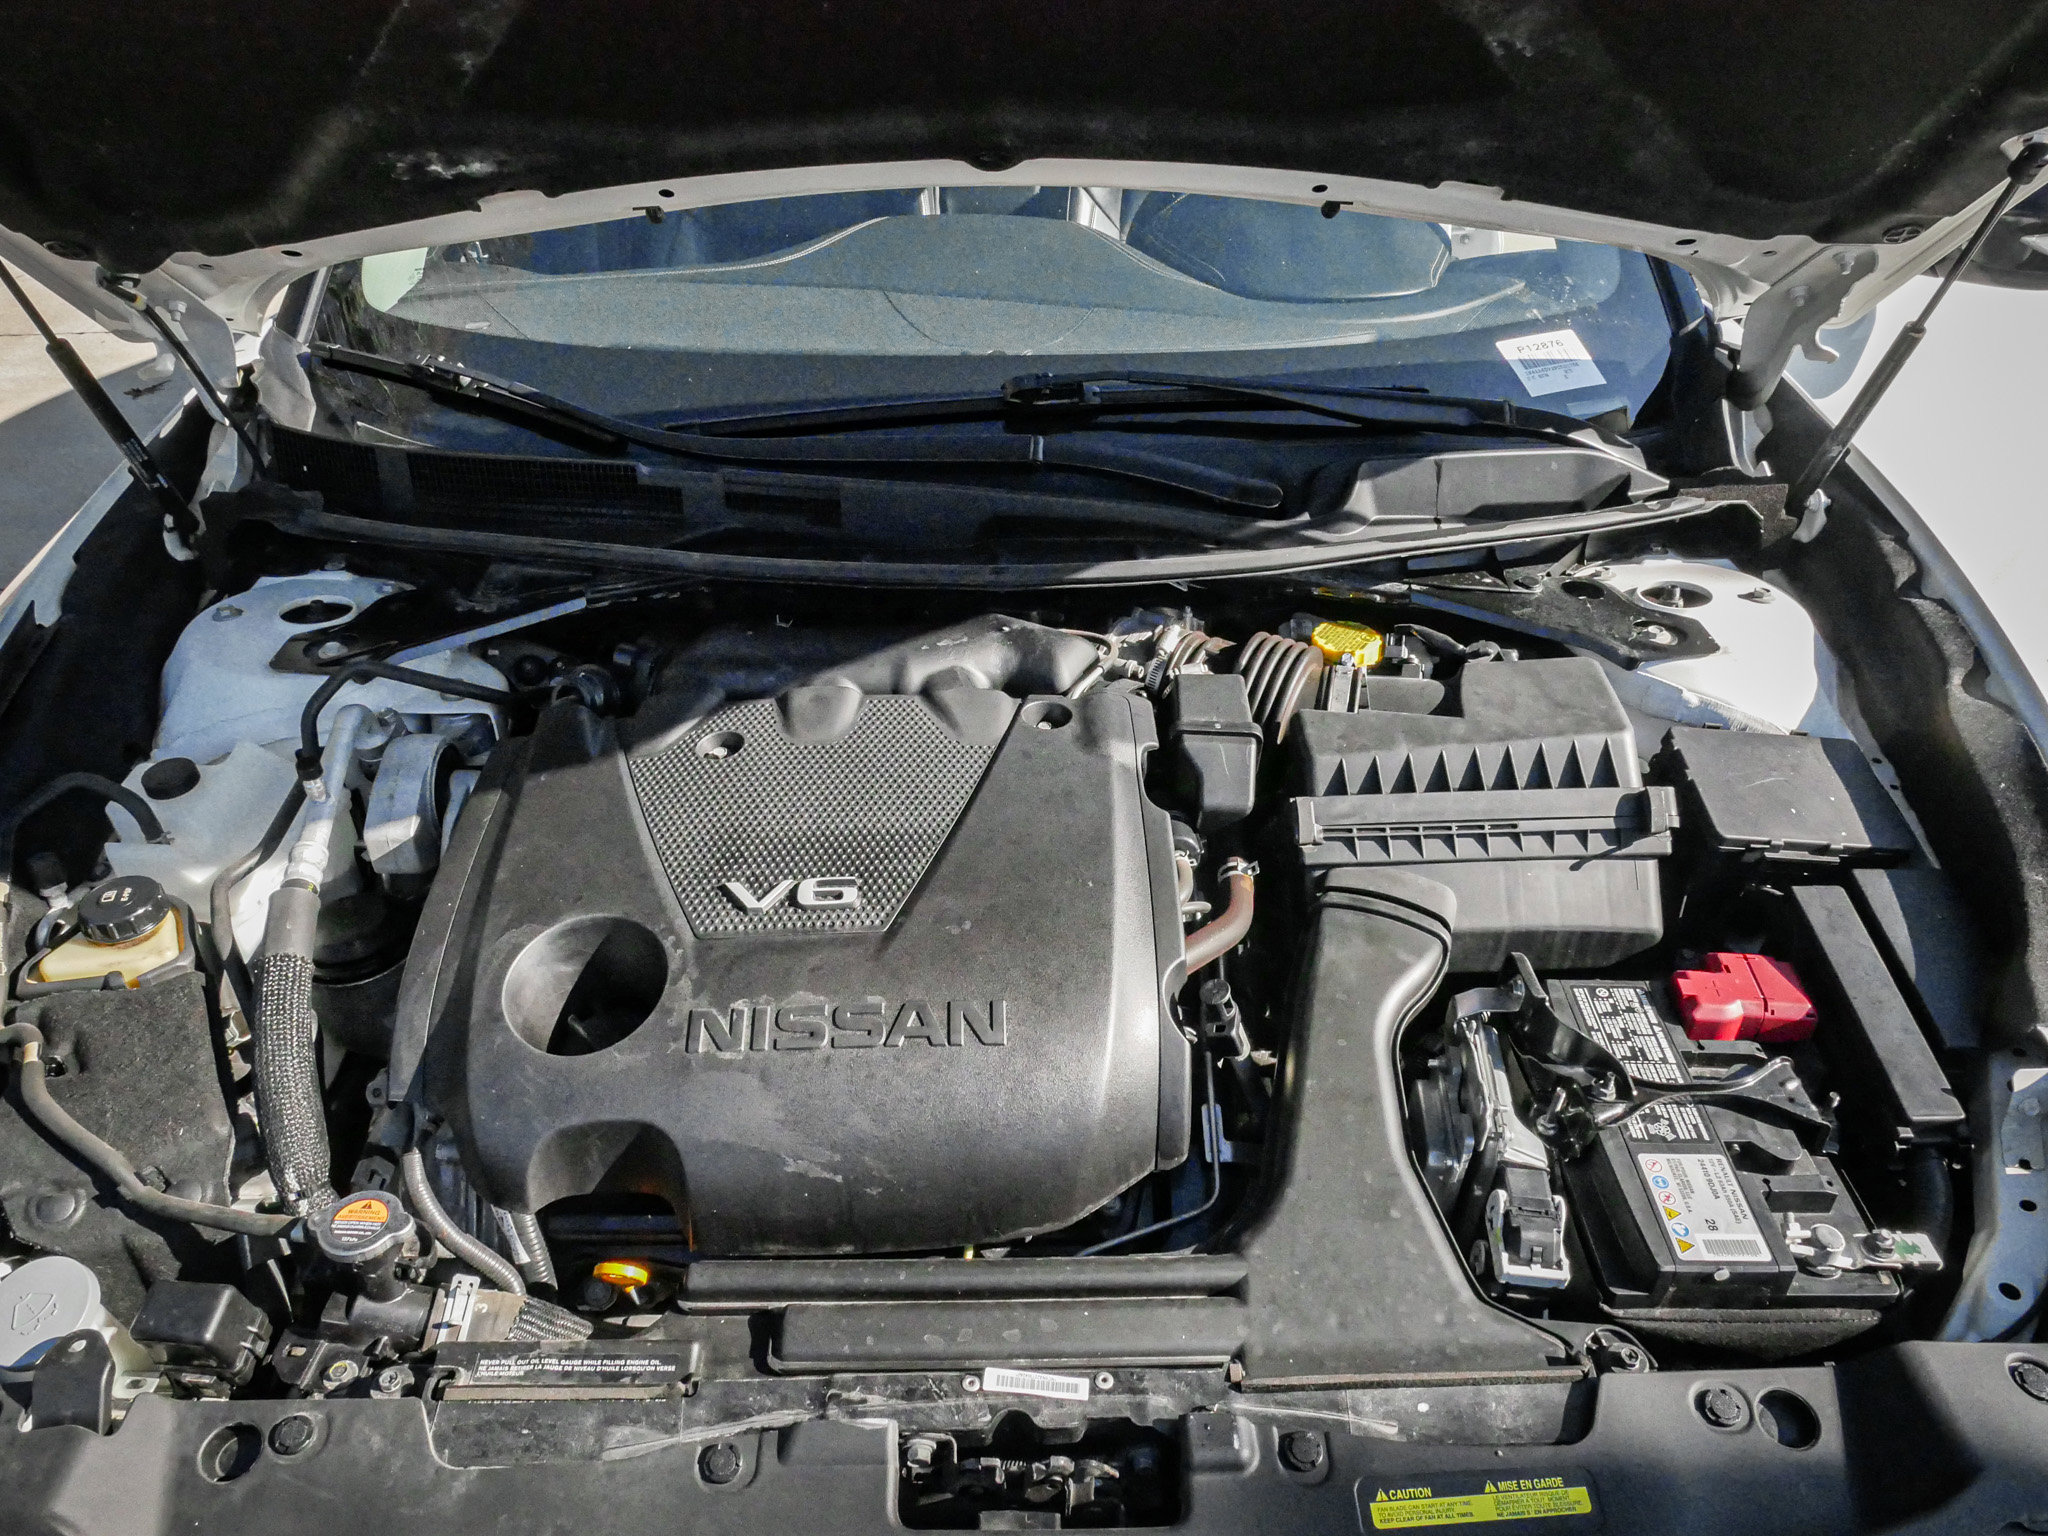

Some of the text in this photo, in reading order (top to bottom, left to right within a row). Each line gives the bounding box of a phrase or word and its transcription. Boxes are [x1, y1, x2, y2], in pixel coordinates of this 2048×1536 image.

[1517, 340, 1564, 353] P12876
[717, 876, 864, 913] V6
[686, 1000, 1007, 1054] NISSAN
[1729, 1189, 1748, 1219] NISSAN
[1704, 1218, 1718, 1230] 28
[1498, 1477, 1564, 1492] MISE EN GARDE
[1389, 1487, 1432, 1500] CAUTION
